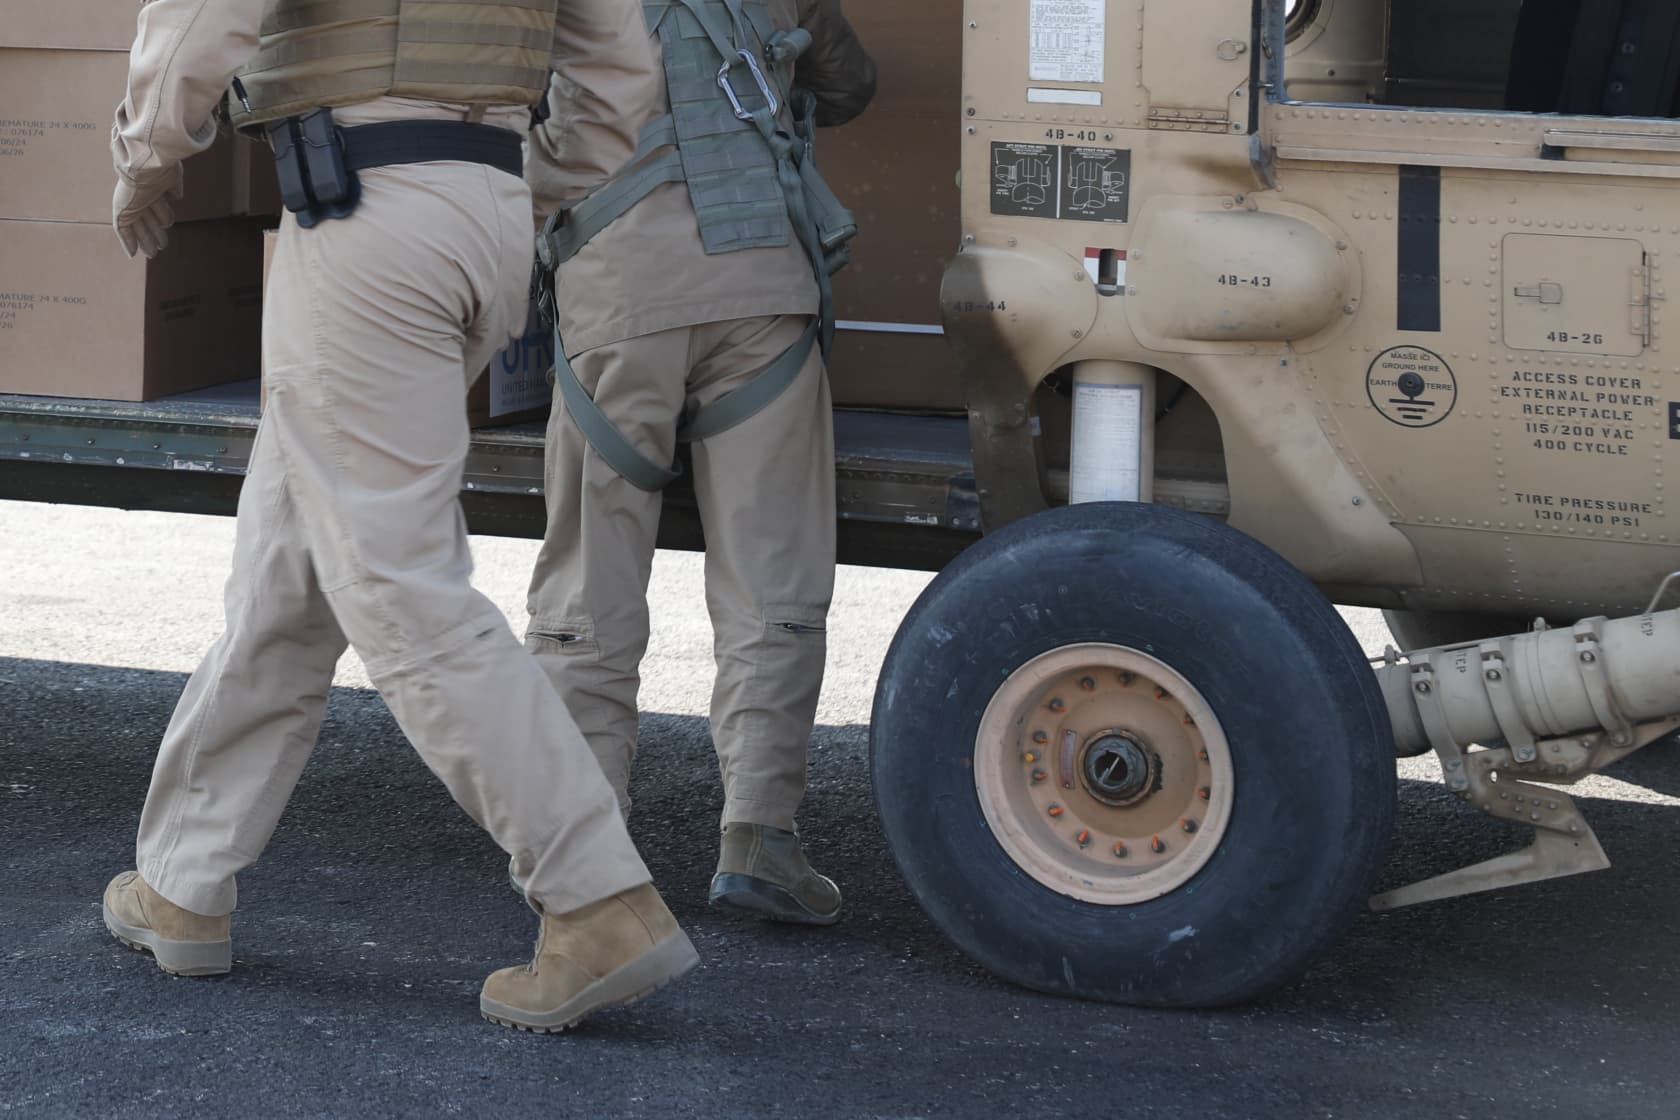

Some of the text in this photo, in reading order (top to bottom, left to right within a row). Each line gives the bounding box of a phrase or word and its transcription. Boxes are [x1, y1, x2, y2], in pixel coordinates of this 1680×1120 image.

[48, 121, 61, 129] 24
[72, 121, 97, 130] 400G
[10, 128, 44, 137] 076174
[1045, 128, 1096, 141] 4B-40
[1217, 274, 1271, 287] 4B-43
[0, 301, 34, 310] 076174
[39, 295, 50, 303] 24
[61, 296, 87, 304] 400G
[953, 300, 1006, 313] 4B-44
[1390, 352, 1418, 361] MASSE
[1382, 362, 1441, 372] GROUND HERE
[1369, 378, 1453, 391] EARTH TERRE
[1512, 370, 1642, 390] ACCESS COVER
[1500, 386, 1655, 407] EXTERNAL POWER
[1523, 403, 1634, 421] RECEPTACLE
[1525, 422, 1634, 441] 115/200 VAC
[1533, 438, 1629, 456] 400 CYCLE
[1514, 492, 1653, 514] TIRE PRESSURE
[1534, 509, 1640, 527] 130/140 PSI
